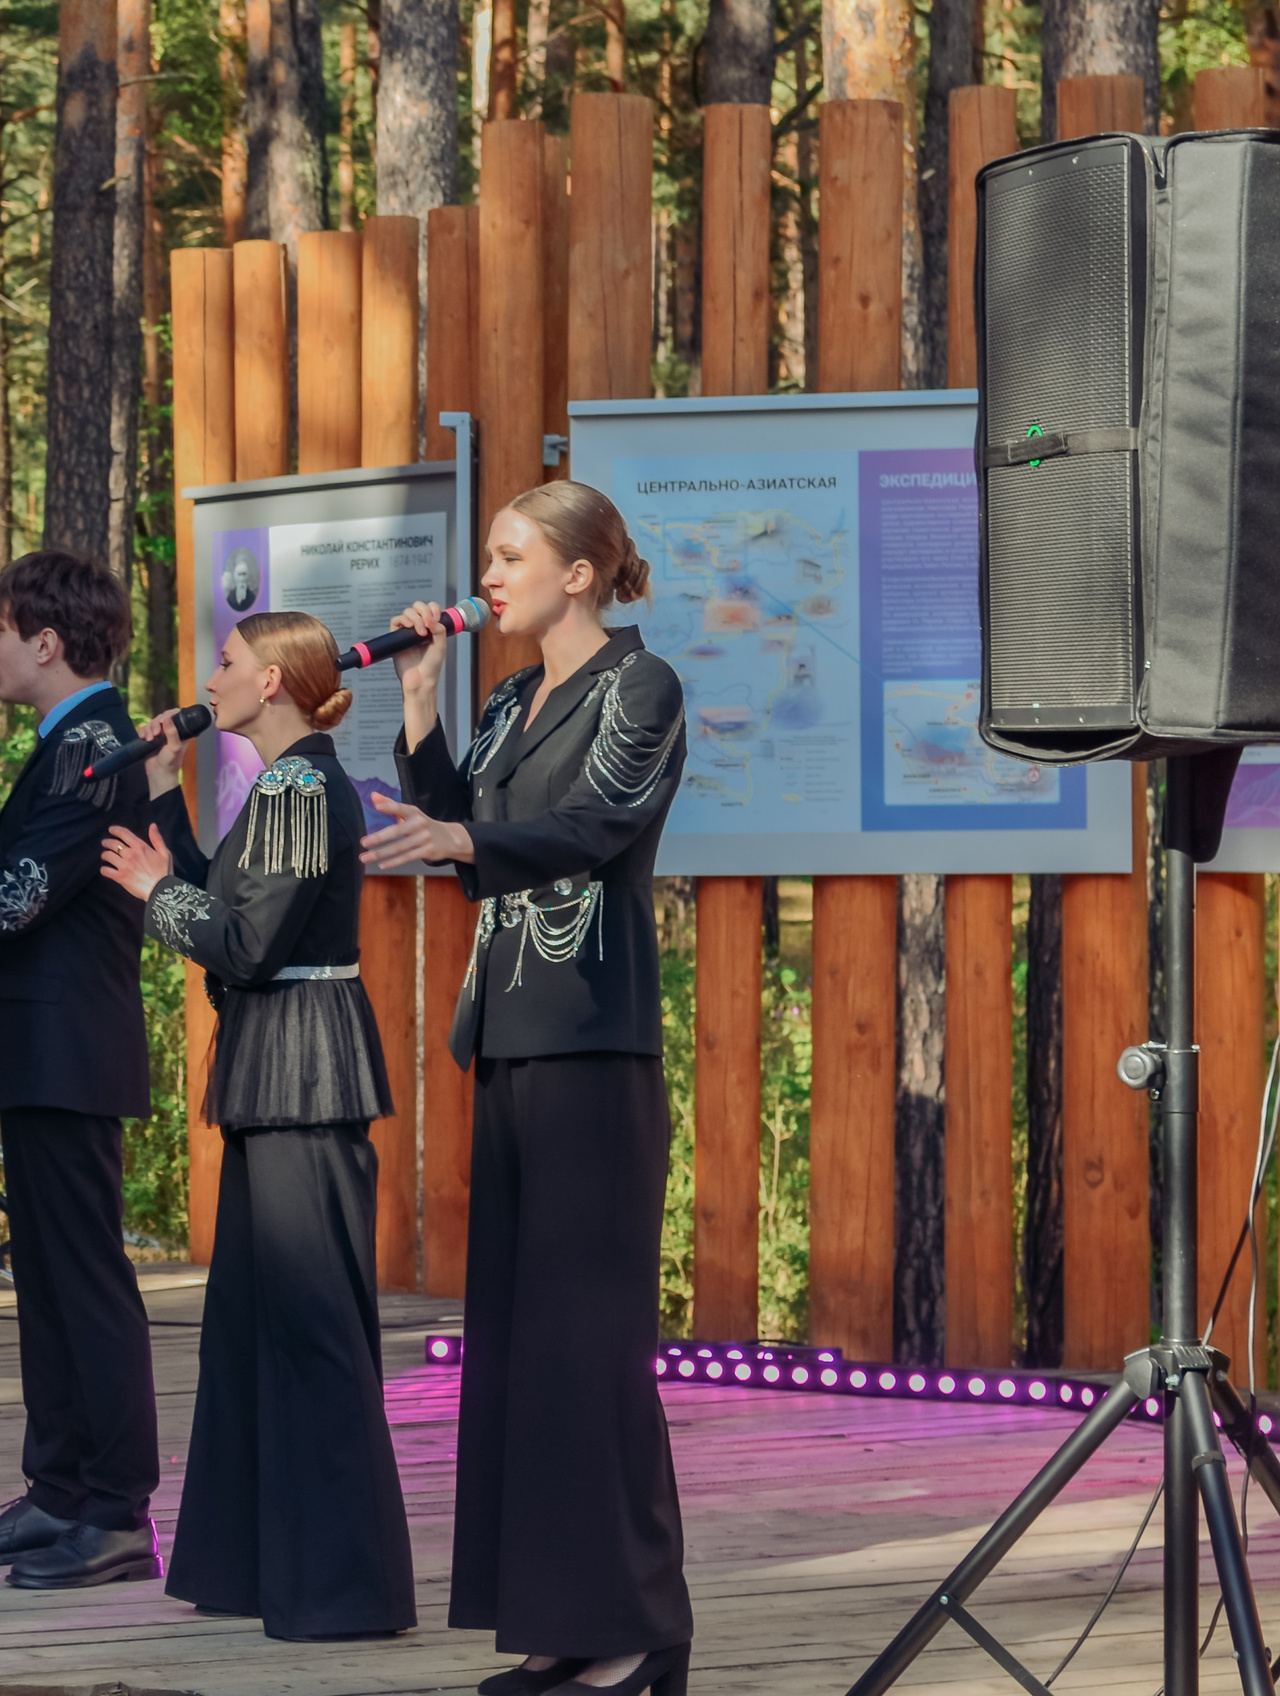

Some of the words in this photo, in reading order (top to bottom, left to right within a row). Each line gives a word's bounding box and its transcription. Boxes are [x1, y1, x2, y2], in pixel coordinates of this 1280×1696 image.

[637, 476, 837, 494] ЦЕНТРАЛЬНО-АЗИАТСКАЯ
[880, 472, 978, 489] ЭКСПЕДИЦИ
[300, 540, 344, 556] НИКОЛАЙ
[346, 535, 433, 553] КОНСТАНТИНОВИЧ
[350, 558, 380, 571] РЕРИХ
